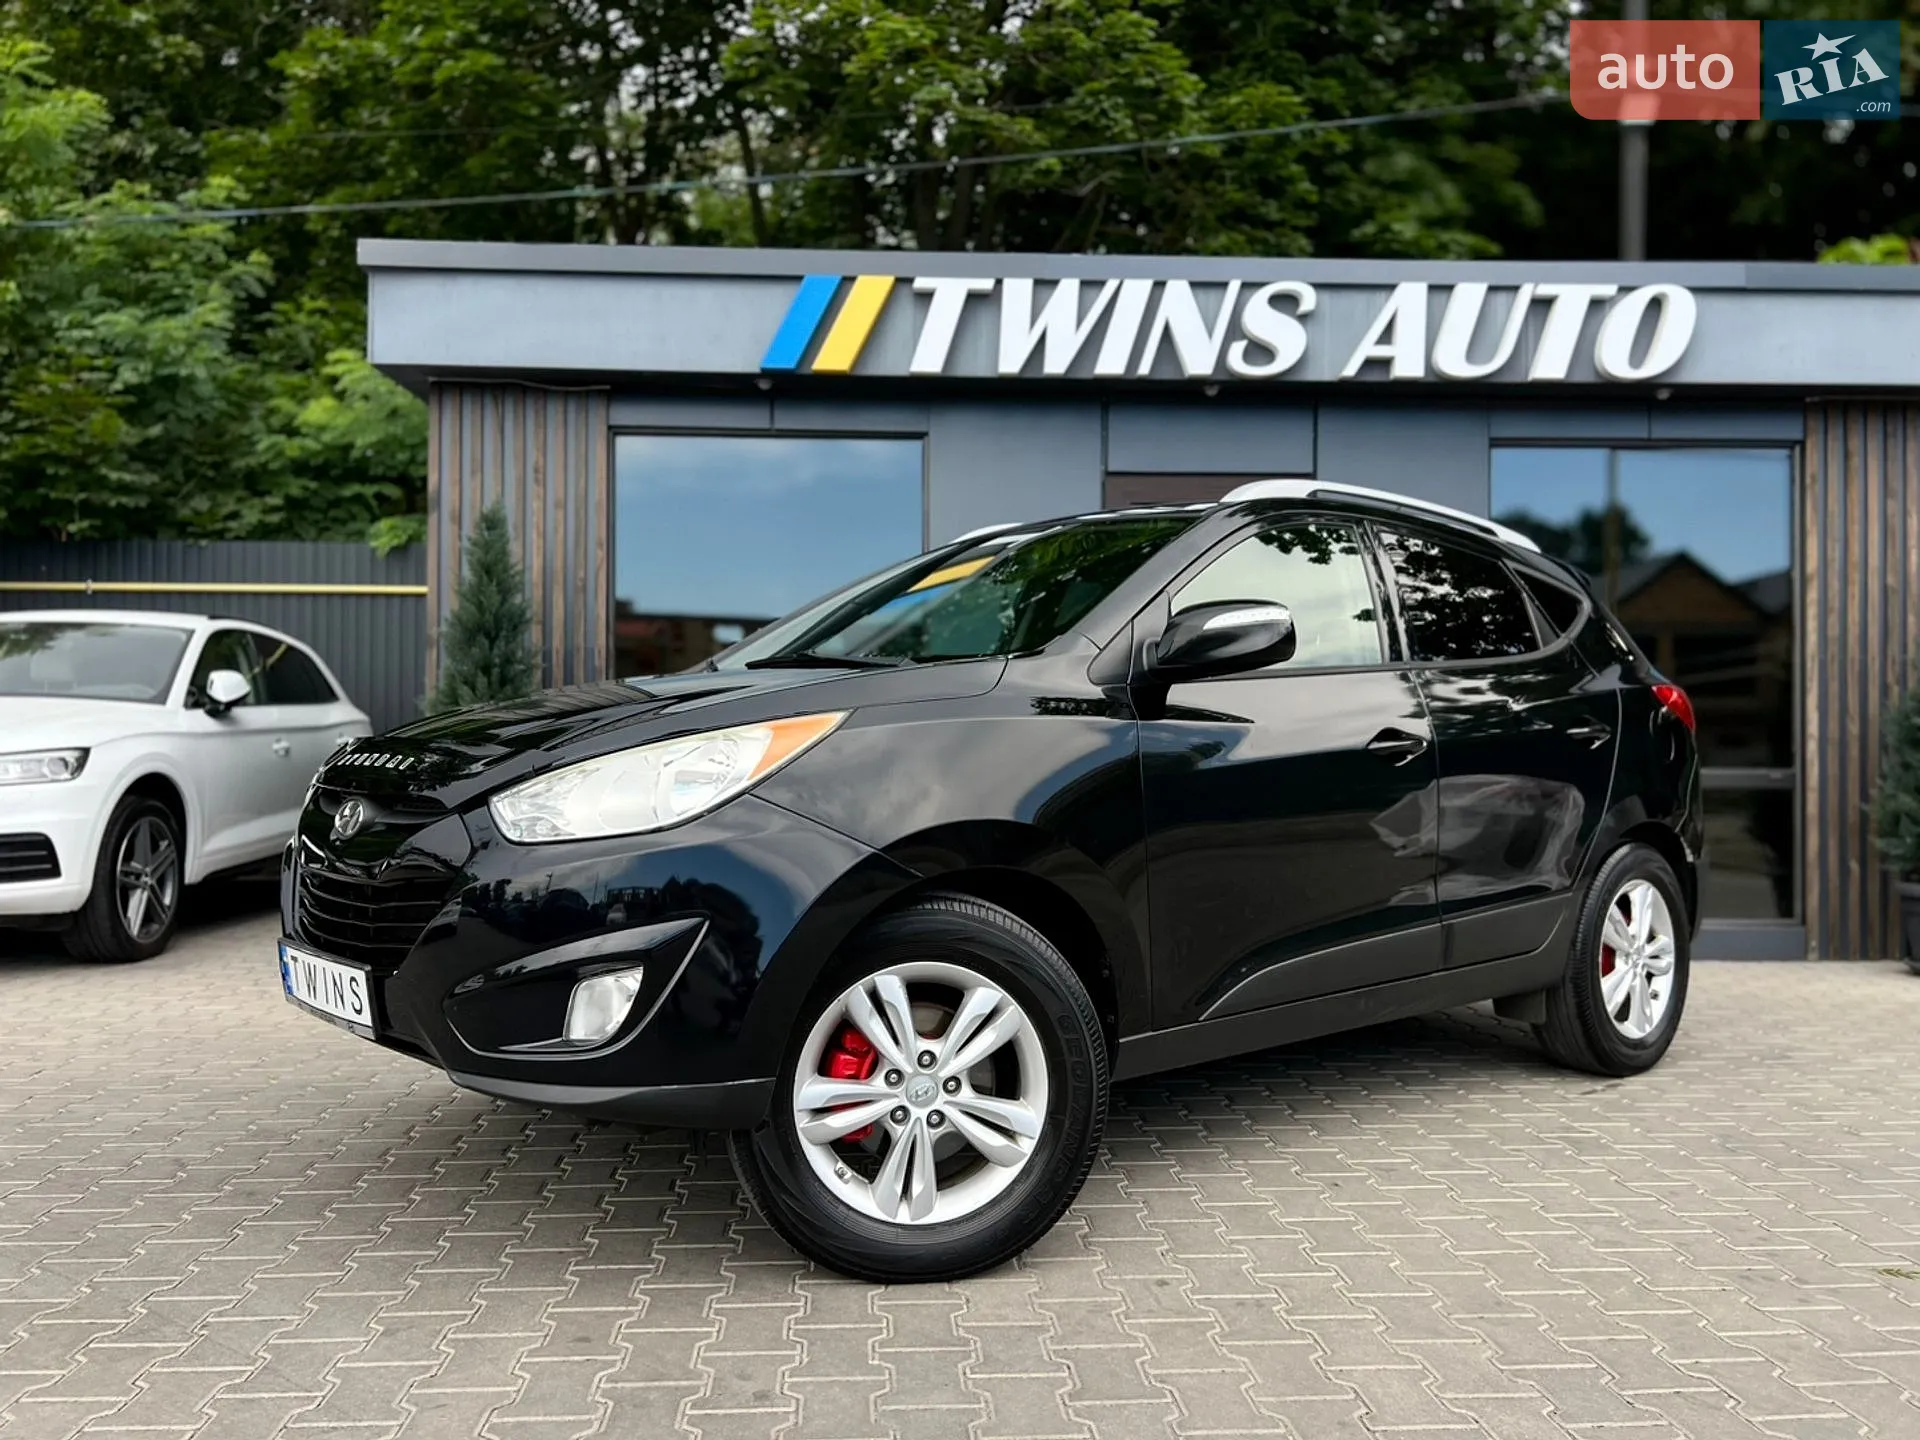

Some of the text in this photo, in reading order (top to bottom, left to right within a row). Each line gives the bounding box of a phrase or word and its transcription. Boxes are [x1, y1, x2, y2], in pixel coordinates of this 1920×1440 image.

[908, 277, 1697, 381] TWINS AUTO
[290, 954, 363, 1015] TWINS
